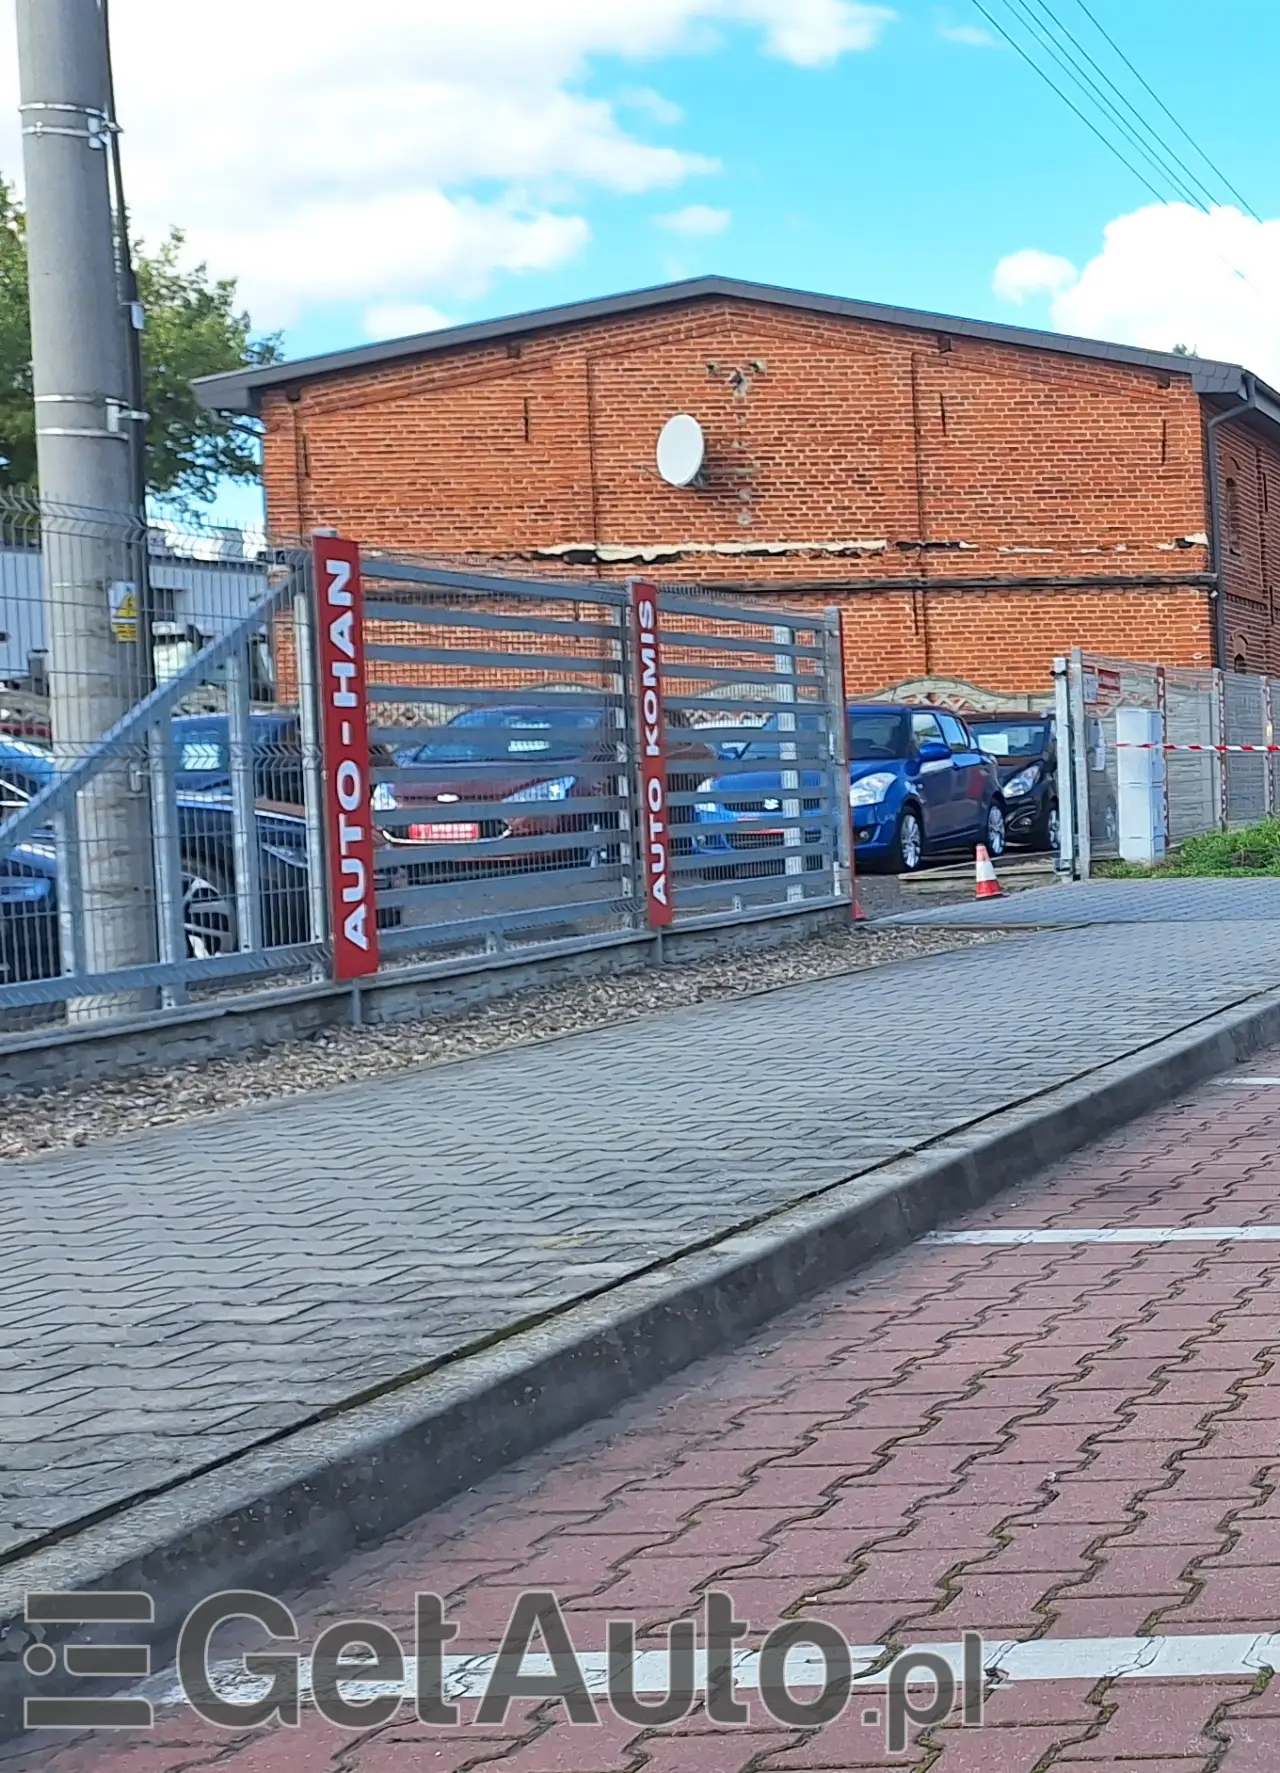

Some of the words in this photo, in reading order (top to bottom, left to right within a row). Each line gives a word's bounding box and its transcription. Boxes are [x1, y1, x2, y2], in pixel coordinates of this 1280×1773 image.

[327, 558, 358, 708] HAN
[638, 599, 660, 757] KOMIS
[336, 758, 369, 951] AUTO
[648, 777, 667, 906] AUTO
